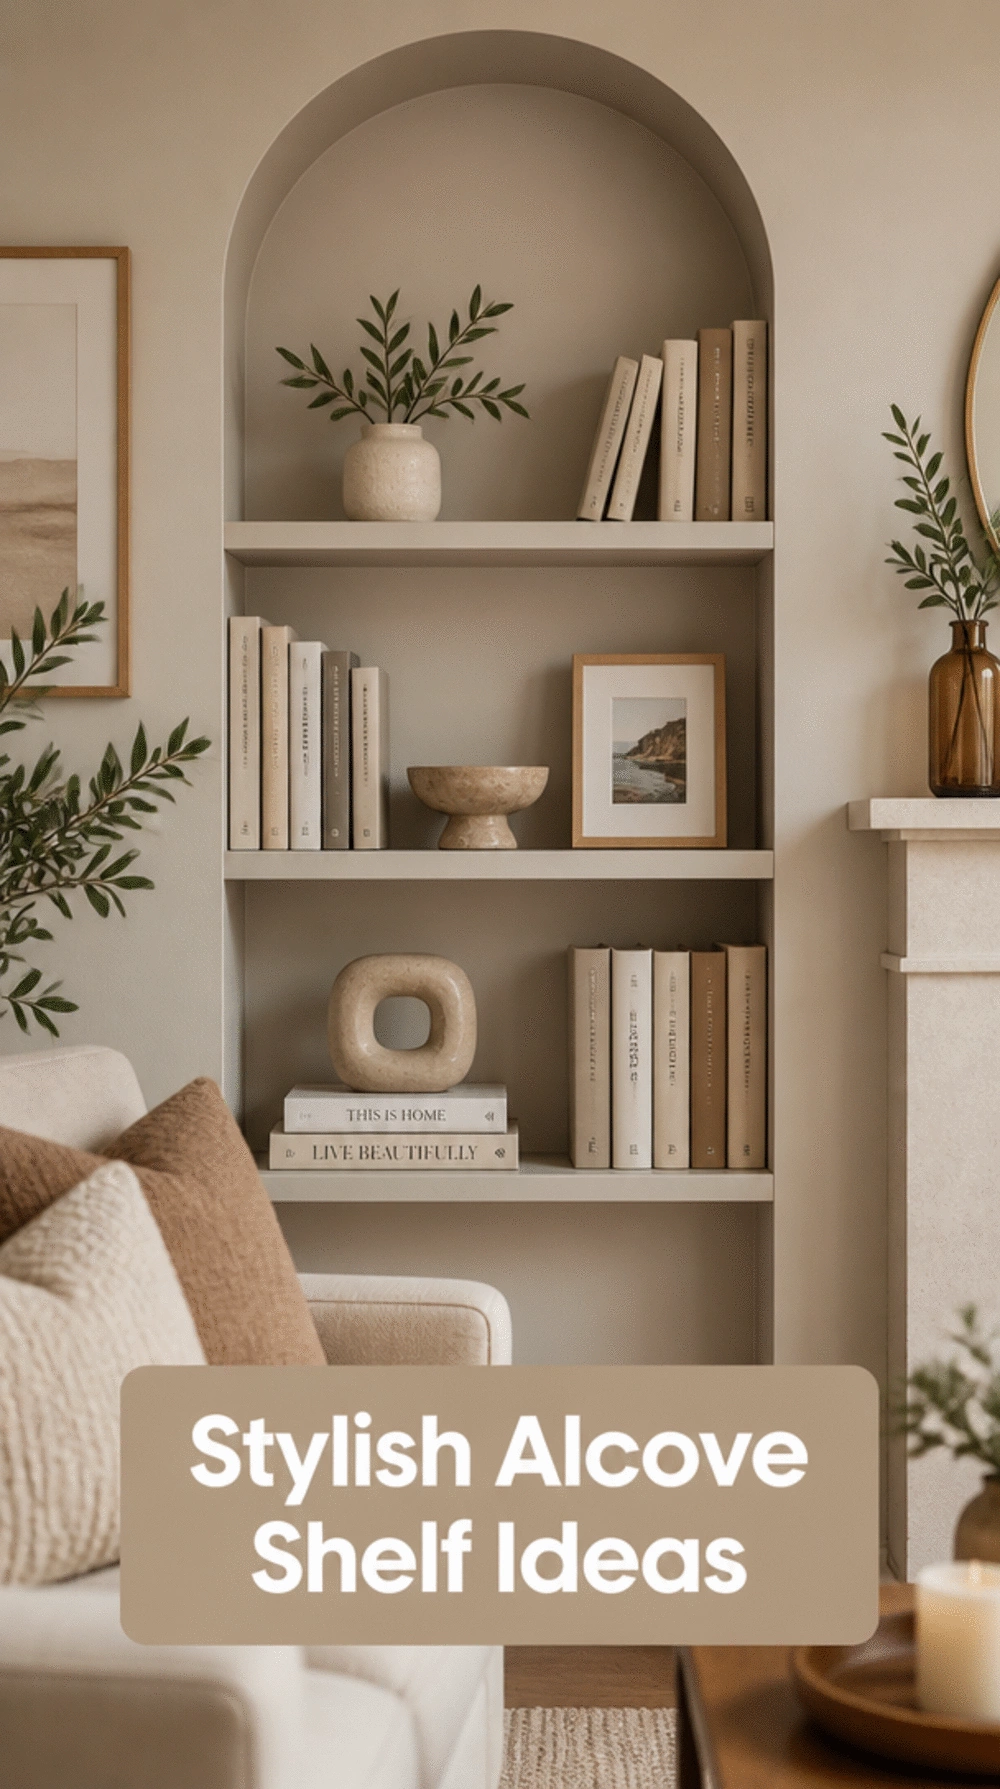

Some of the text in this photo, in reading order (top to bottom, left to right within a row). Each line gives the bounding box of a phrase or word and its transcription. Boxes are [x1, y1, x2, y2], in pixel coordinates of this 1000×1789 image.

[346, 1109, 447, 1122] THIS IS HOME
[312, 1145, 353, 1160] LIVE
[359, 1145, 478, 1160] BEAUTIFULLY
